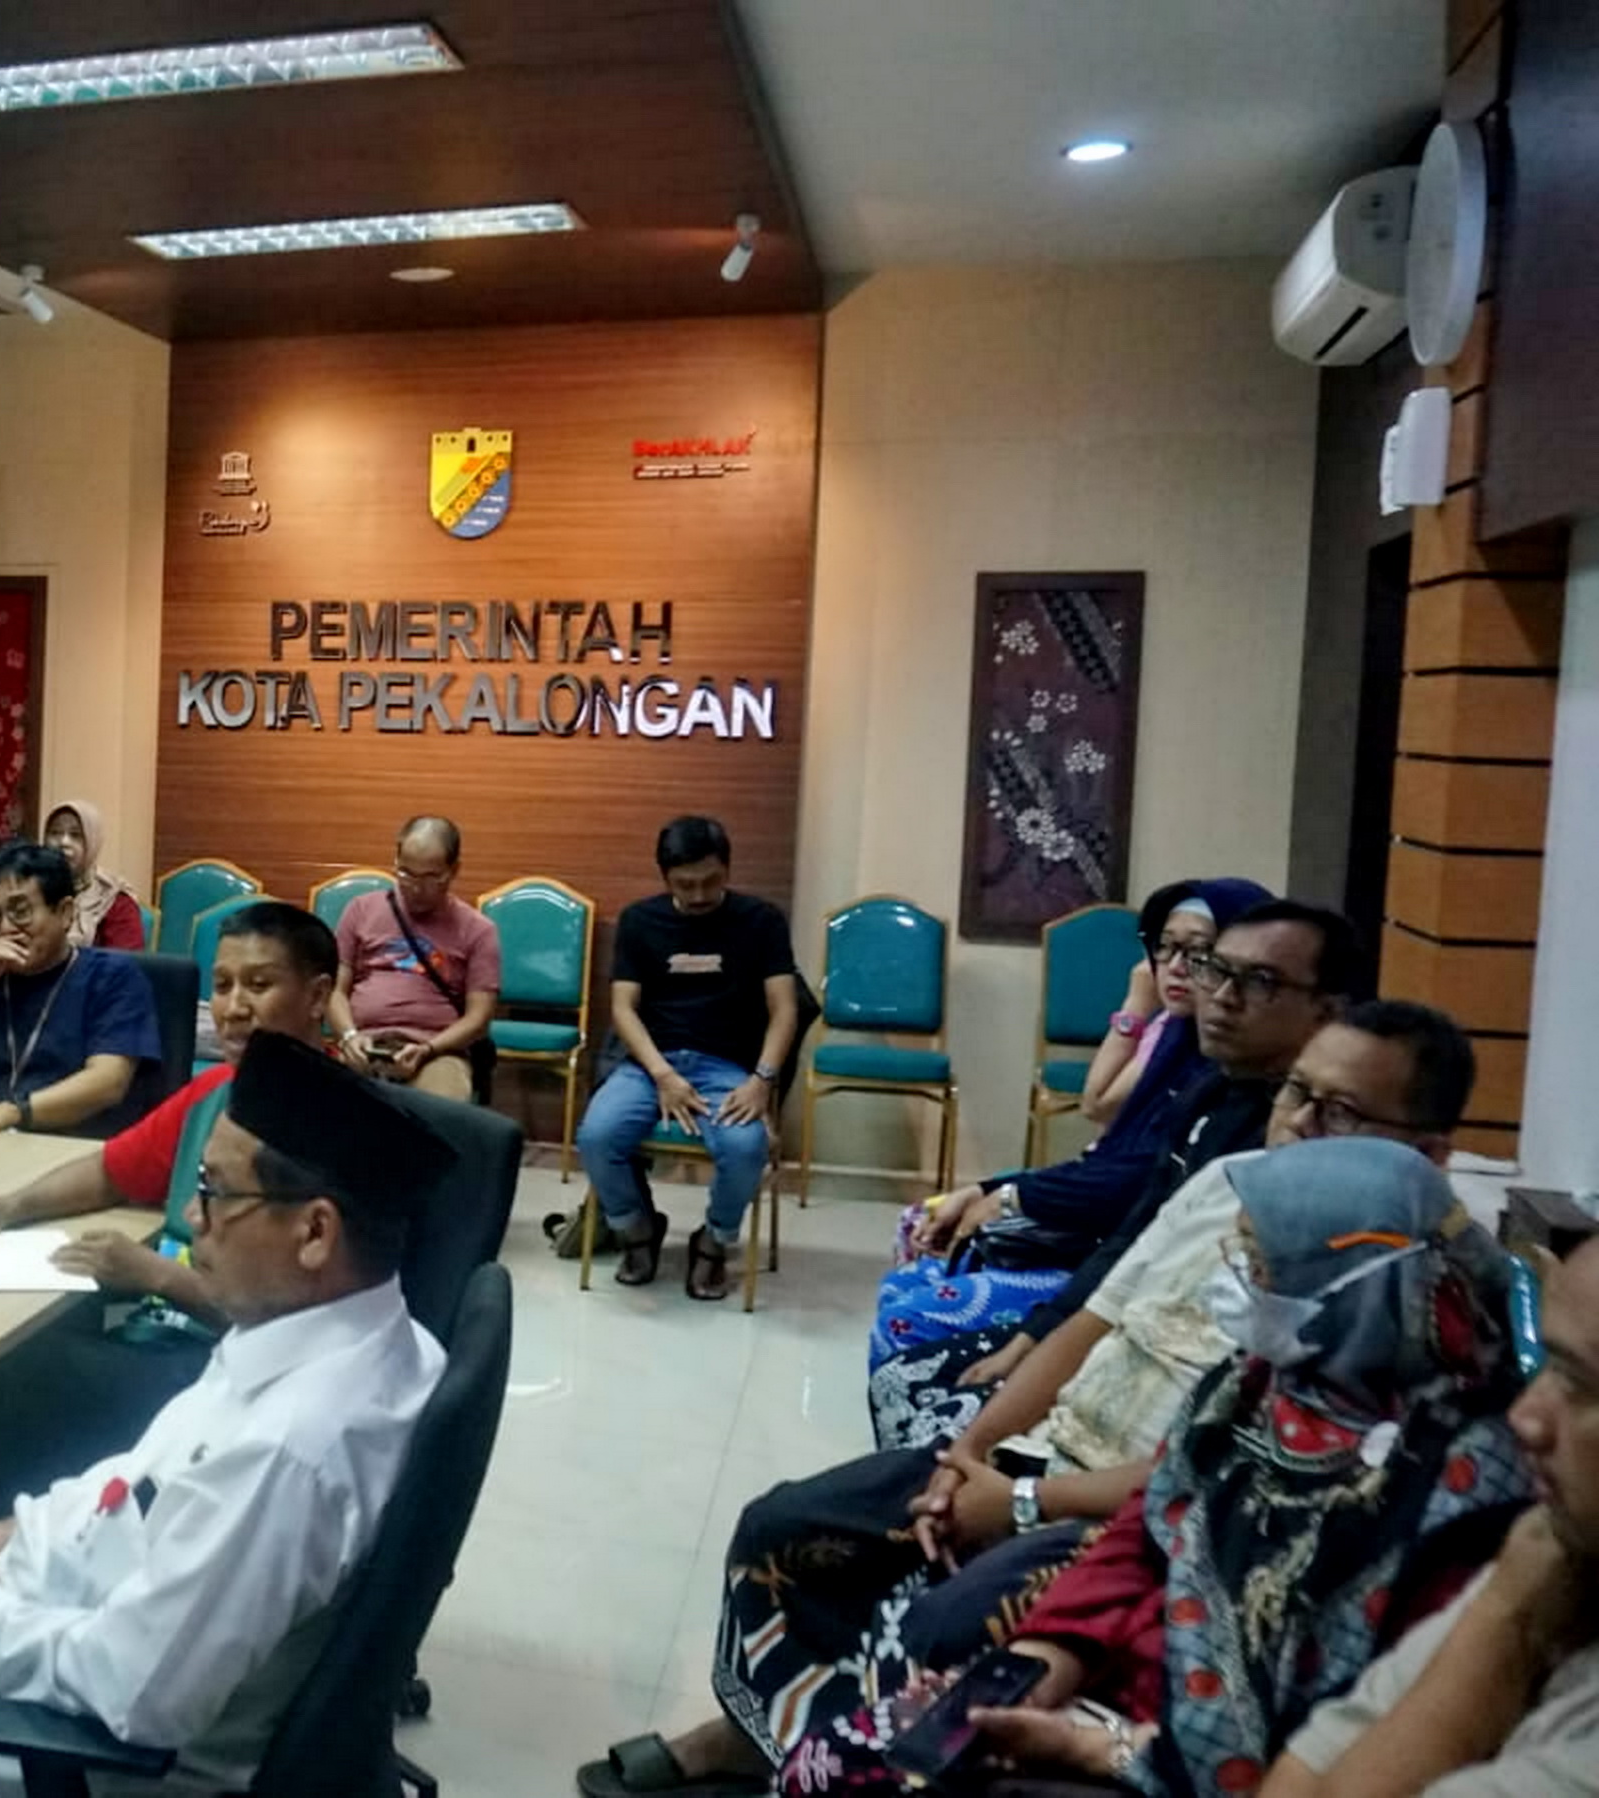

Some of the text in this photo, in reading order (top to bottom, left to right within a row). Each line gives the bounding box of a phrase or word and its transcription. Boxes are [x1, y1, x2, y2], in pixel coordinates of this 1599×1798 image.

[270, 601, 673, 664] PEMERINTAH
[176, 671, 778, 739] KOTA PEKALONGAN
